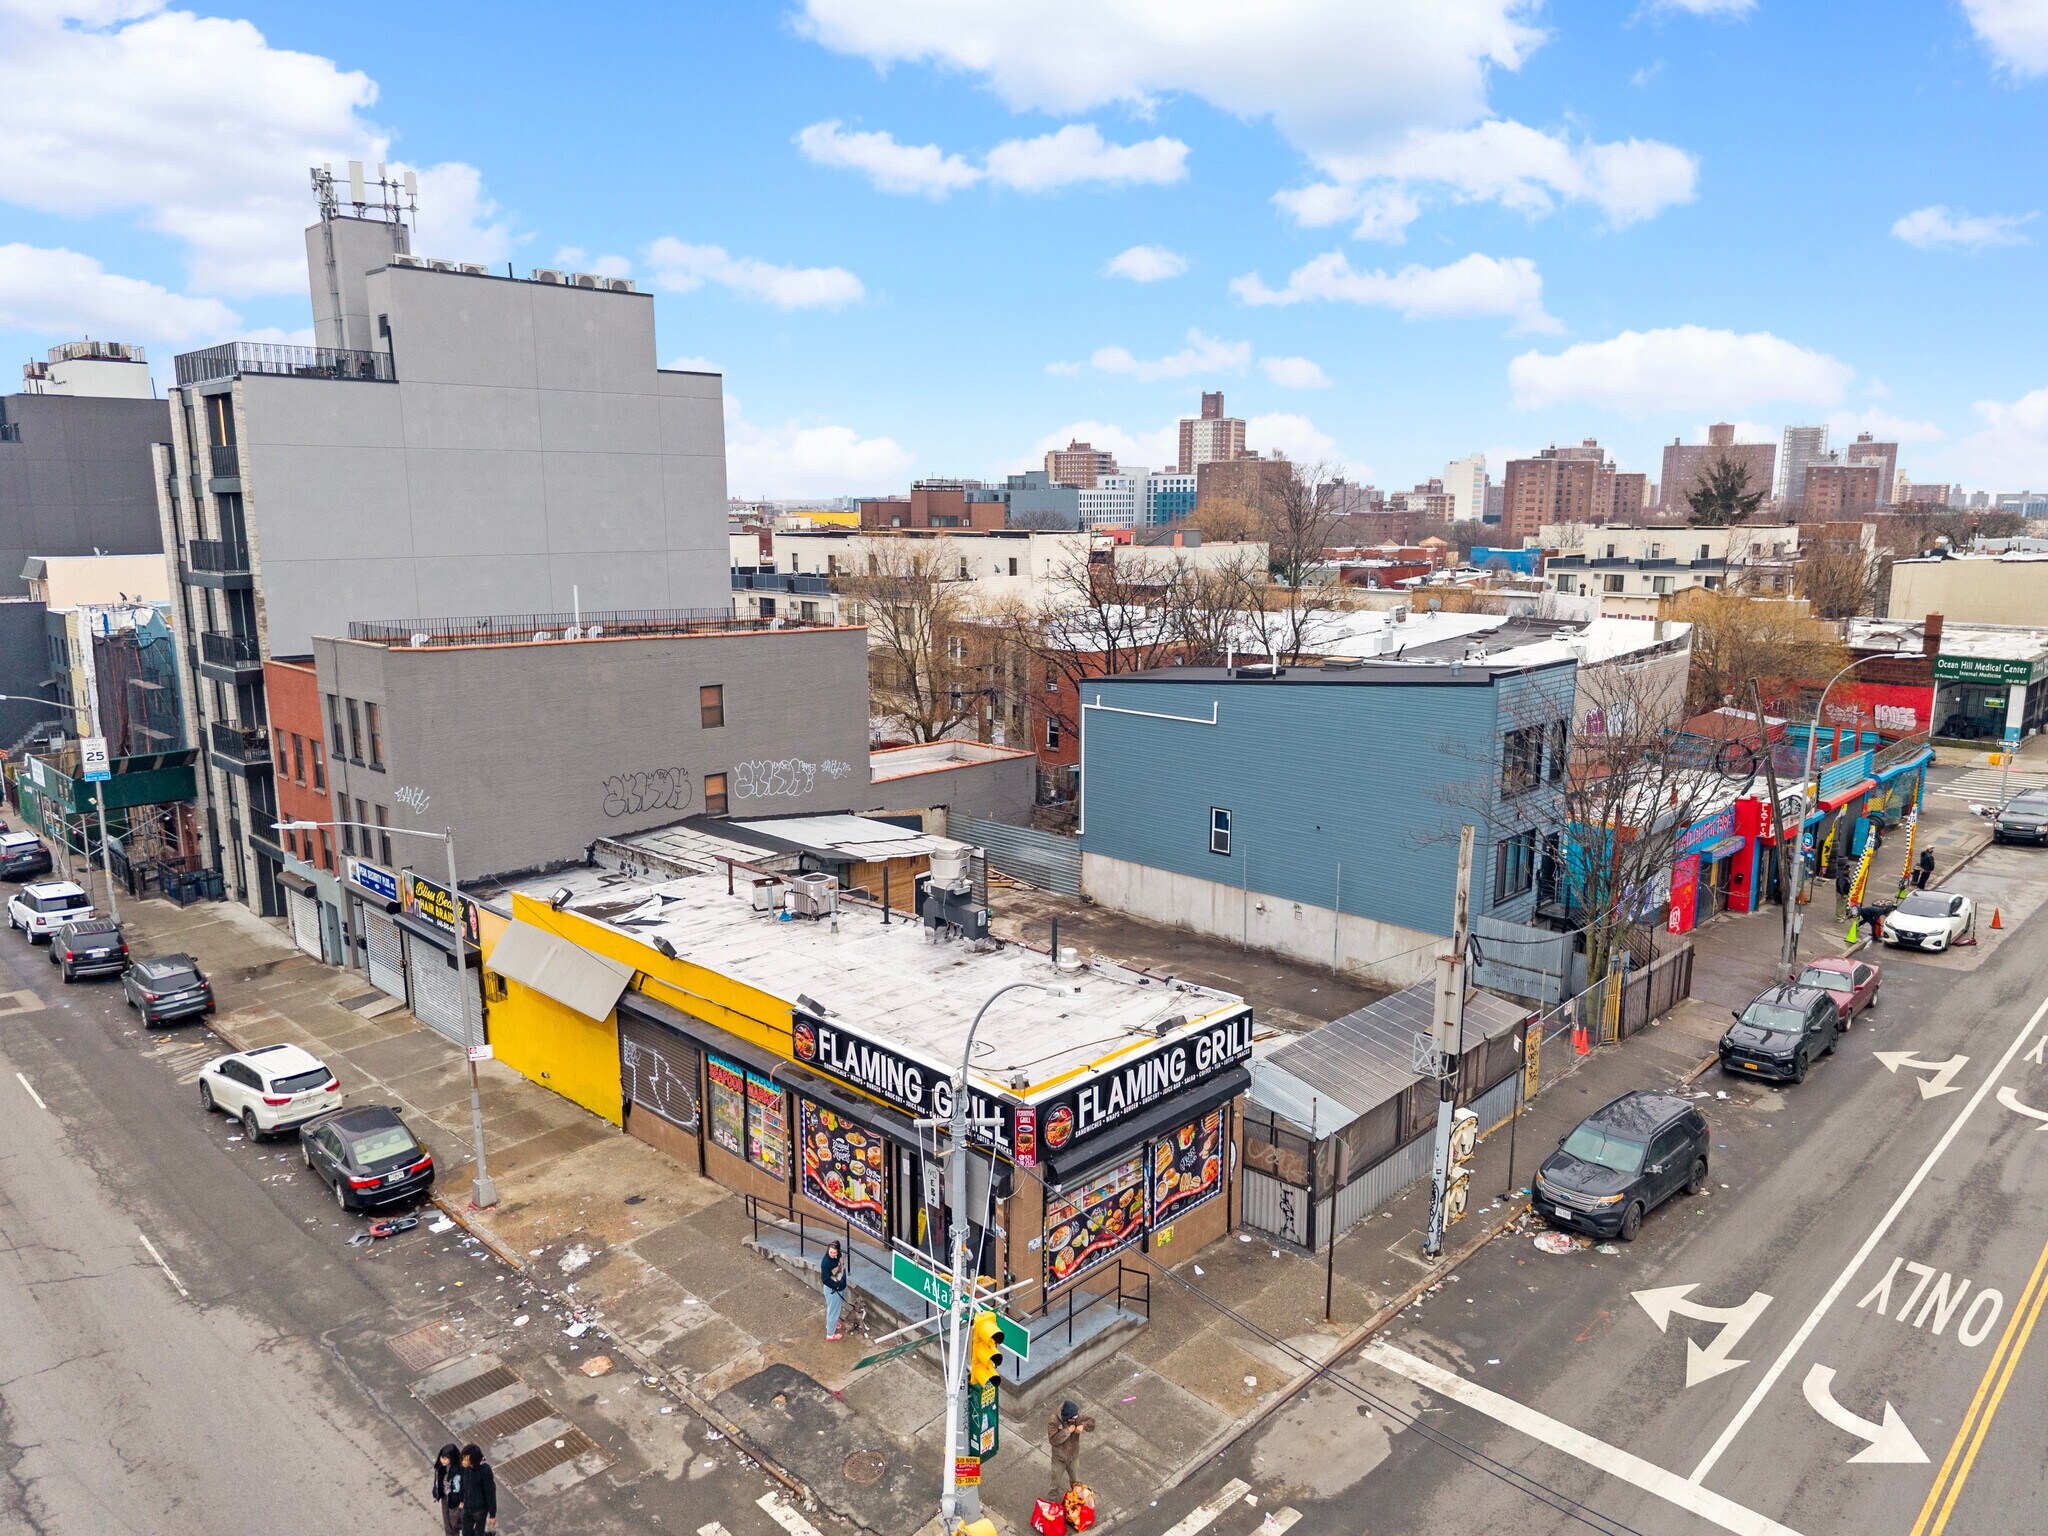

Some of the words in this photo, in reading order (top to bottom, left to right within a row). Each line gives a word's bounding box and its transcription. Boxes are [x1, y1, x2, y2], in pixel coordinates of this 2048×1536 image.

[1938, 659, 1959, 669] Ocean
[1960, 661, 1973, 670] Hill
[1974, 662, 2001, 672] Medical
[2003, 664, 2027, 674] Center
[86, 751, 105, 761] 25
[415, 881, 436, 901] Bliss
[420, 898, 435, 915] HAIR
[435, 905, 455, 924] BRAID
[818, 1028, 922, 1104] FLAMING
[1079, 1048, 1186, 1129] FLAMING
[1196, 1017, 1252, 1070] GRILL
[708, 1063, 744, 1093] SEAFOOD
[747, 1082, 781, 1112] MARKET
[1075, 1119, 1102, 1138] SANDWICHES
[1105, 1111, 1120, 1123] WRAPS
[1123, 1101, 1139, 1114] BURGER
[1142, 1093, 1160, 1105] GROCERY
[1163, 1086, 1173, 1095] JUICE
[1173, 1081, 1181, 1090] BAR
[1184, 1074, 1196, 1085] SALAD
[1223, 1056, 1234, 1065] LOTTO
[1236, 1048, 1250, 1059] SNACKS
[824, 1062, 847, 1078] SANDWICHES
[850, 1074, 863, 1085] WRAPS
[866, 1082, 881, 1094] BURGER
[884, 1090, 903, 1104] GROCERY
[906, 1102, 917, 1111] JUICE
[995, 1142, 1013, 1156] NACKS
[1016, 1109, 1034, 1117] FLAMING
[923, 1277, 951, 1304] Atla
[1856, 1256, 2004, 1347] ONLY
